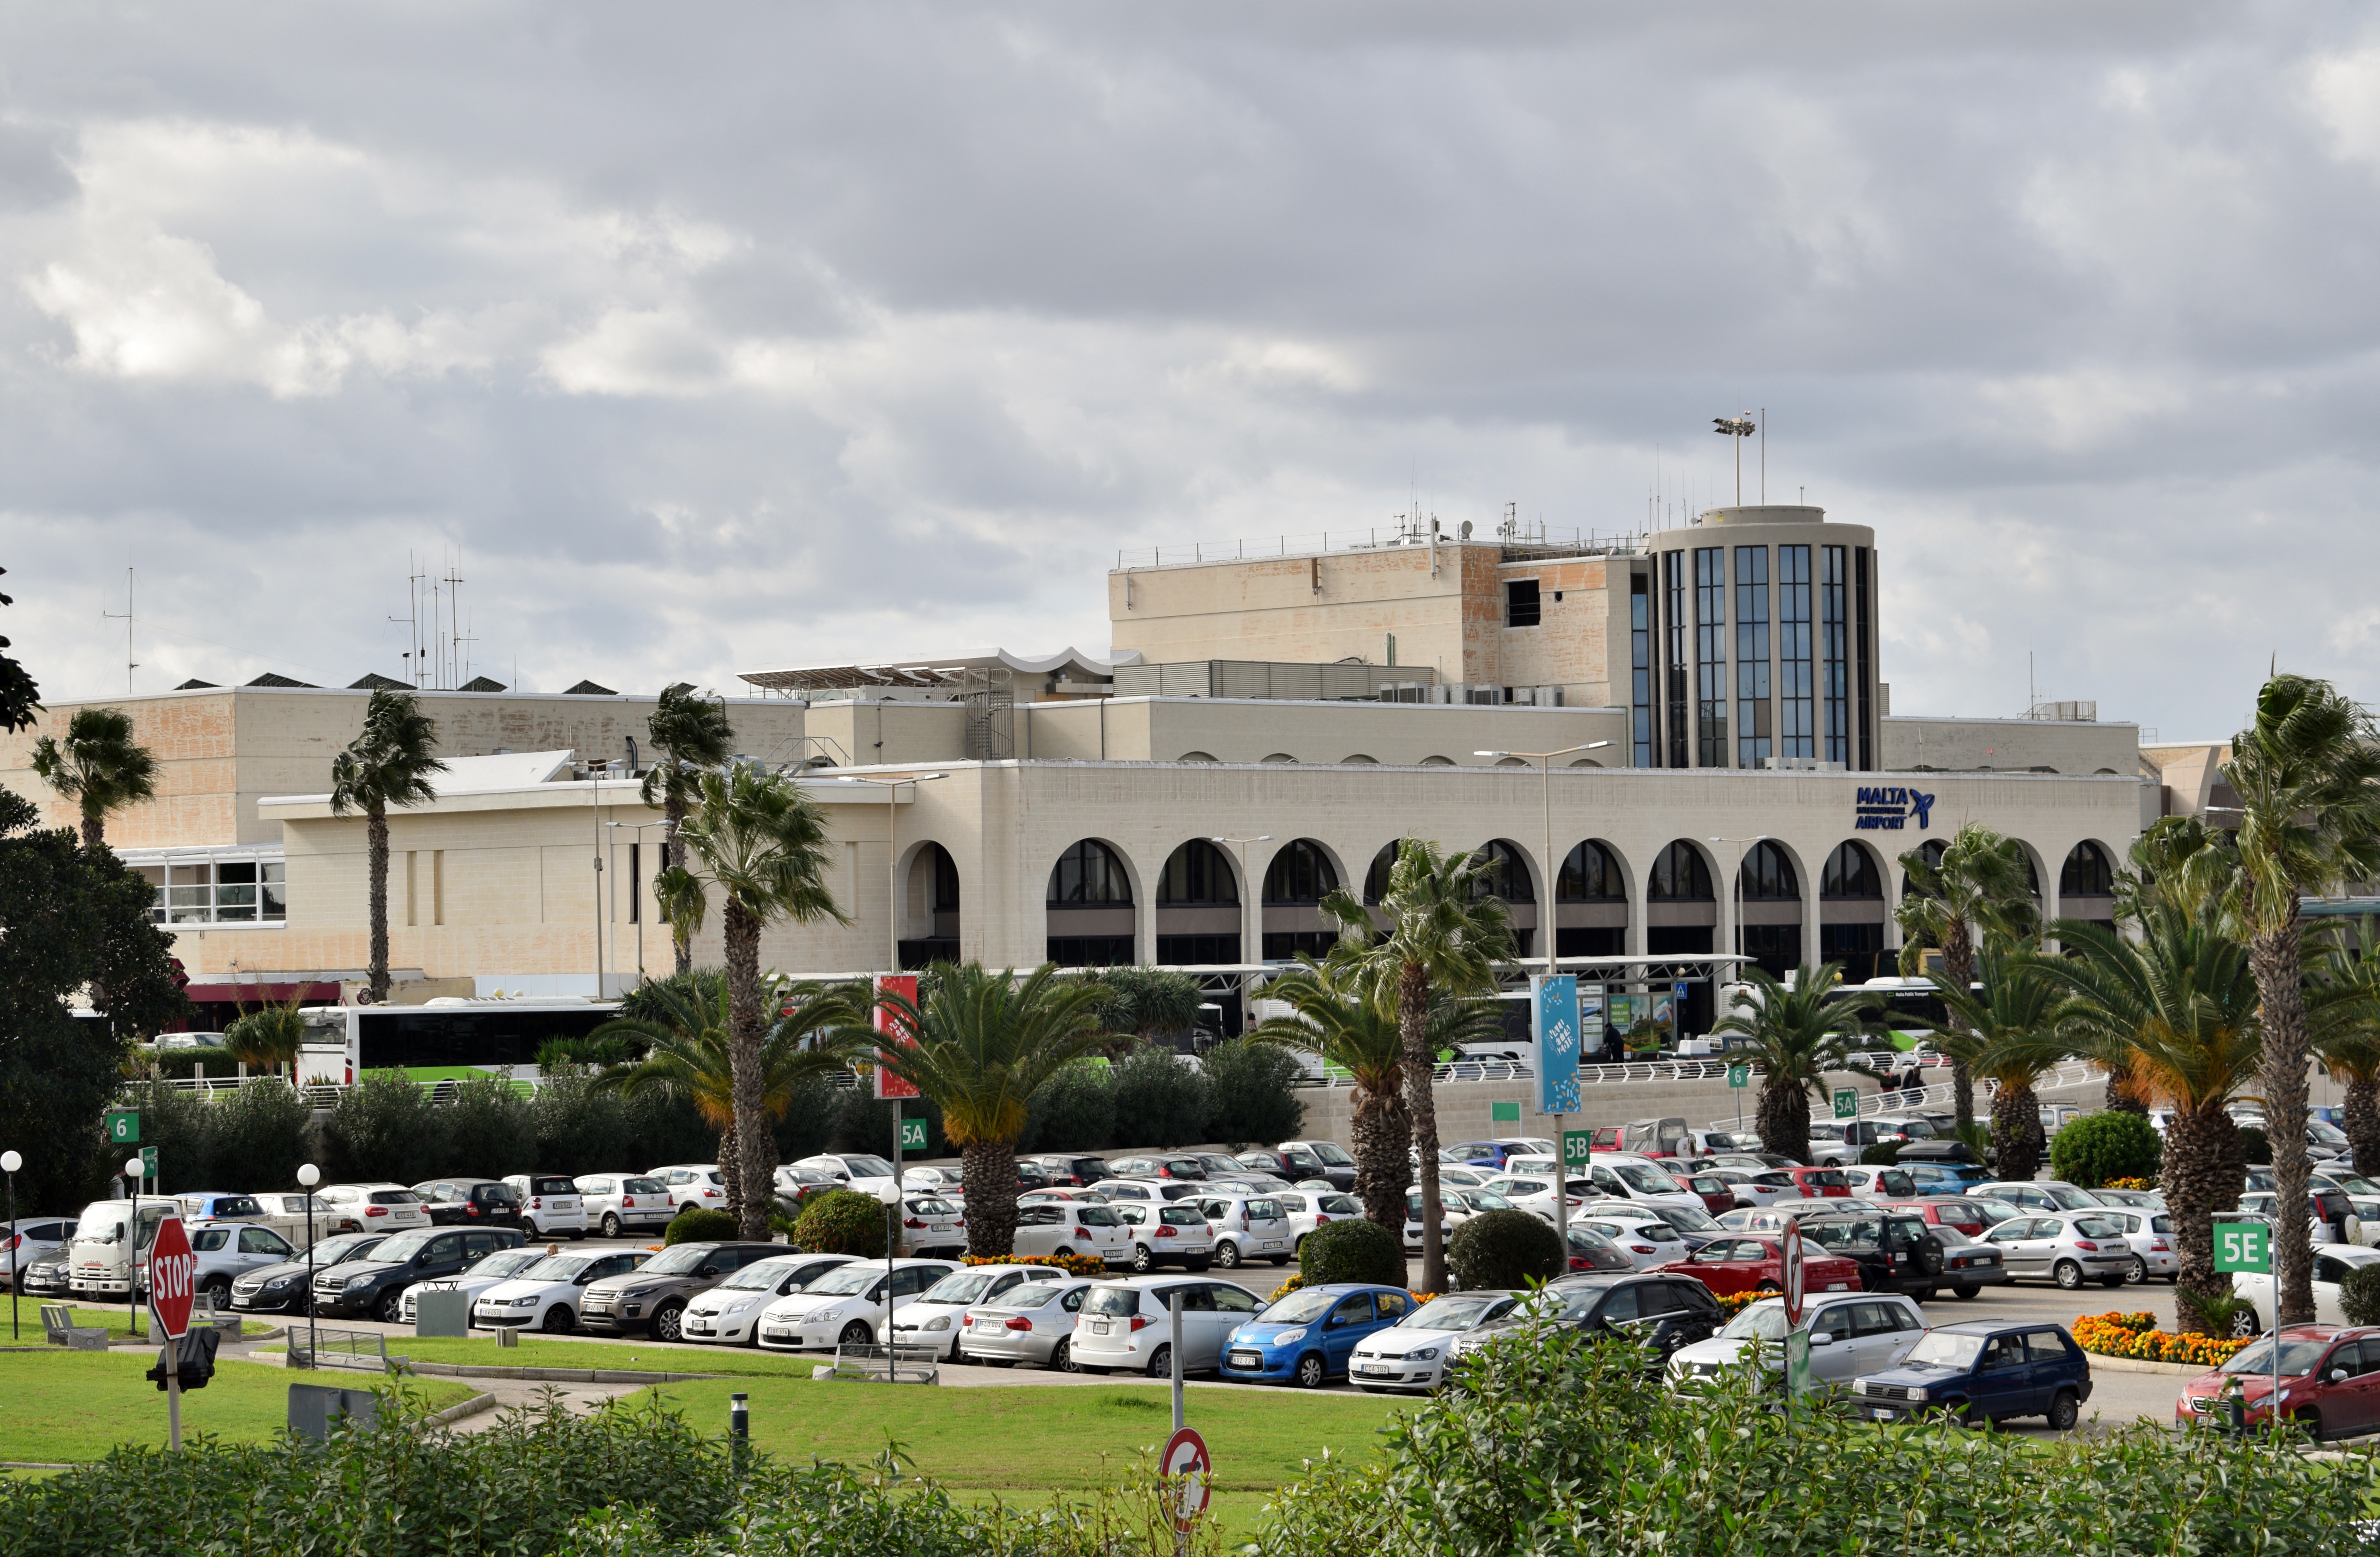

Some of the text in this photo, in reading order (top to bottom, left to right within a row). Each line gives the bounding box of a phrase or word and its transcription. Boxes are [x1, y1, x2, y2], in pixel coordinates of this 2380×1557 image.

[1857, 787, 1908, 805] MALTA
[1856, 806, 1907, 814] INTERNATIONAL
[1855, 816, 1907, 830] AIRPORT
[1735, 1070, 1741, 1083] 6
[1837, 1097, 1853, 1113] 5A
[116, 1119, 127, 1136] 6
[903, 1125, 925, 1144] 5A
[1566, 1137, 1587, 1158] 5B
[2224, 1233, 2258, 1262] 5E
[155, 1253, 191, 1300] STOP
[1793, 1338, 1804, 1362] Exit
